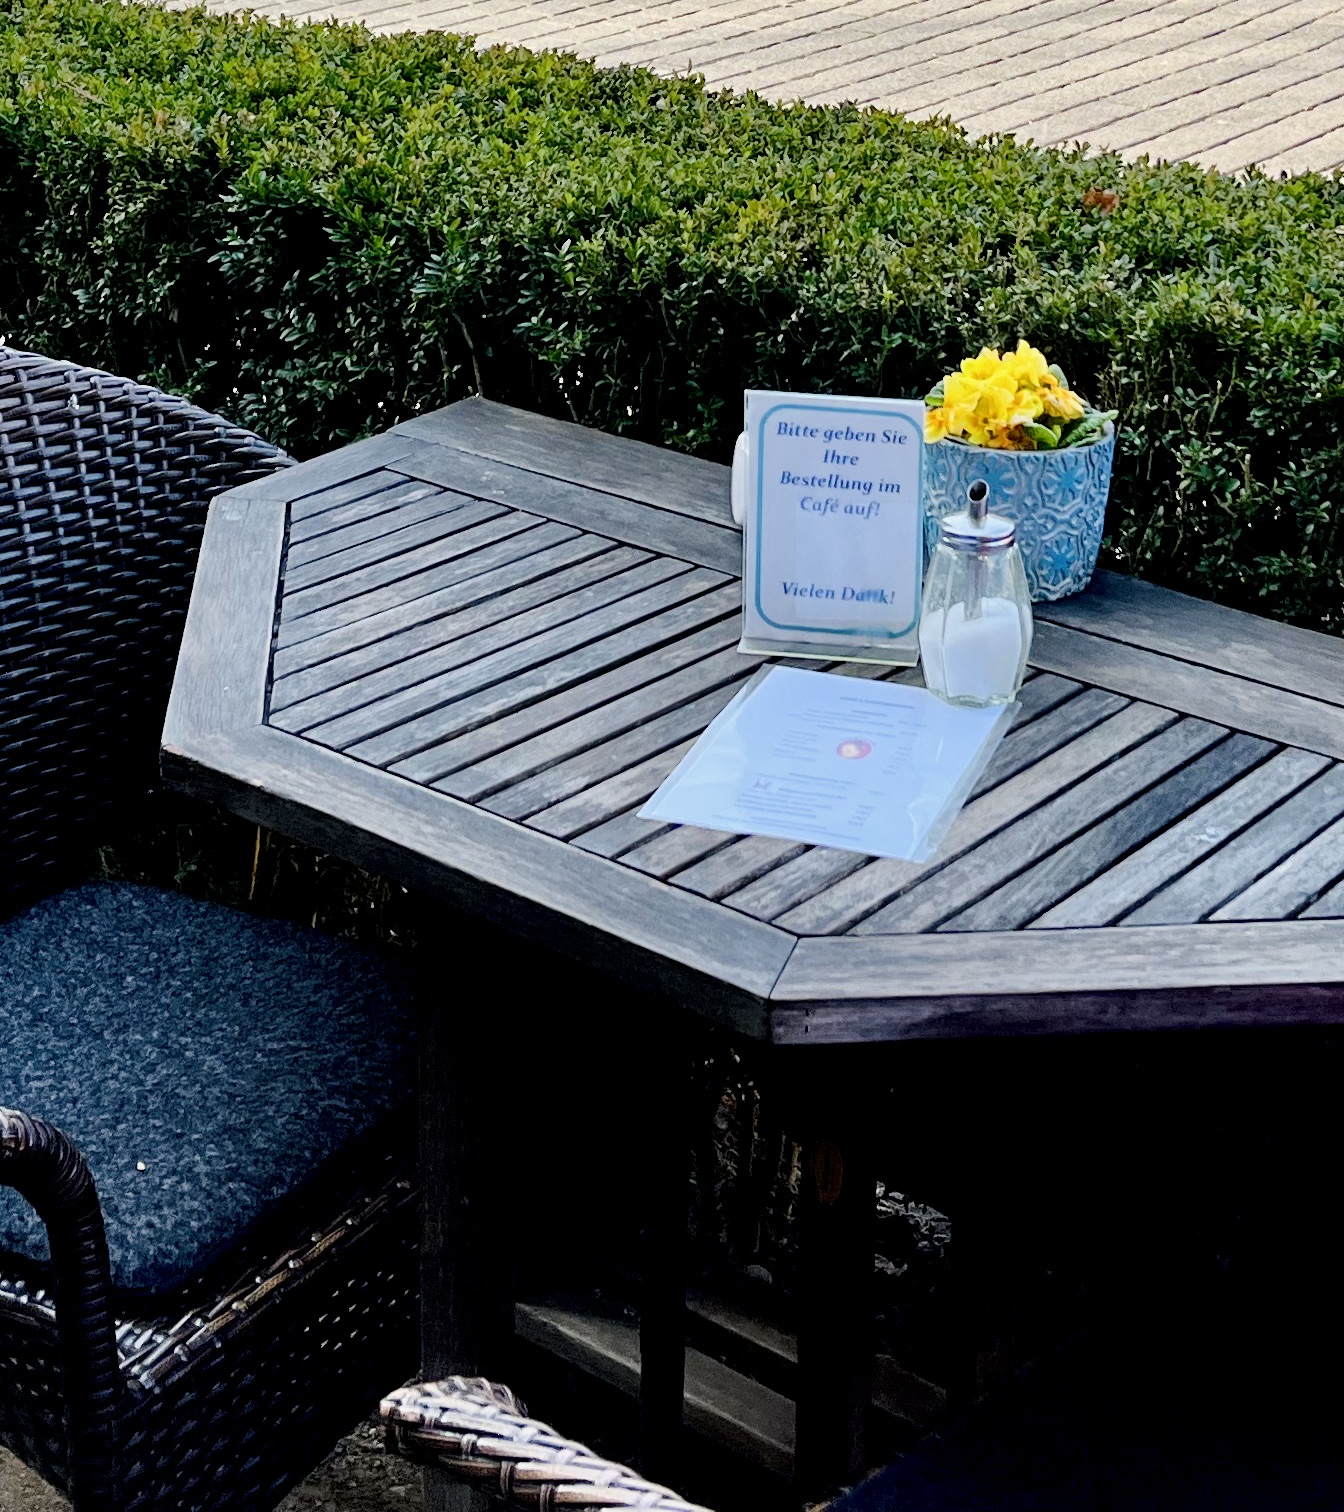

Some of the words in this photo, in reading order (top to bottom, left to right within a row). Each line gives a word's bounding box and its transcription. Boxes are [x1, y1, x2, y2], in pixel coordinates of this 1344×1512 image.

[776, 421, 819, 438] Bitte
[823, 426, 876, 443] geben
[881, 429, 908, 445] Sie
[823, 449, 859, 466] Ihre
[780, 471, 873, 495] Bestellung
[878, 478, 901, 494] im
[800, 496, 839, 517] Café
[843, 501, 880, 519] auf!
[782, 581, 835, 599] Vielen
[841, 586, 895, 604] Dank!
